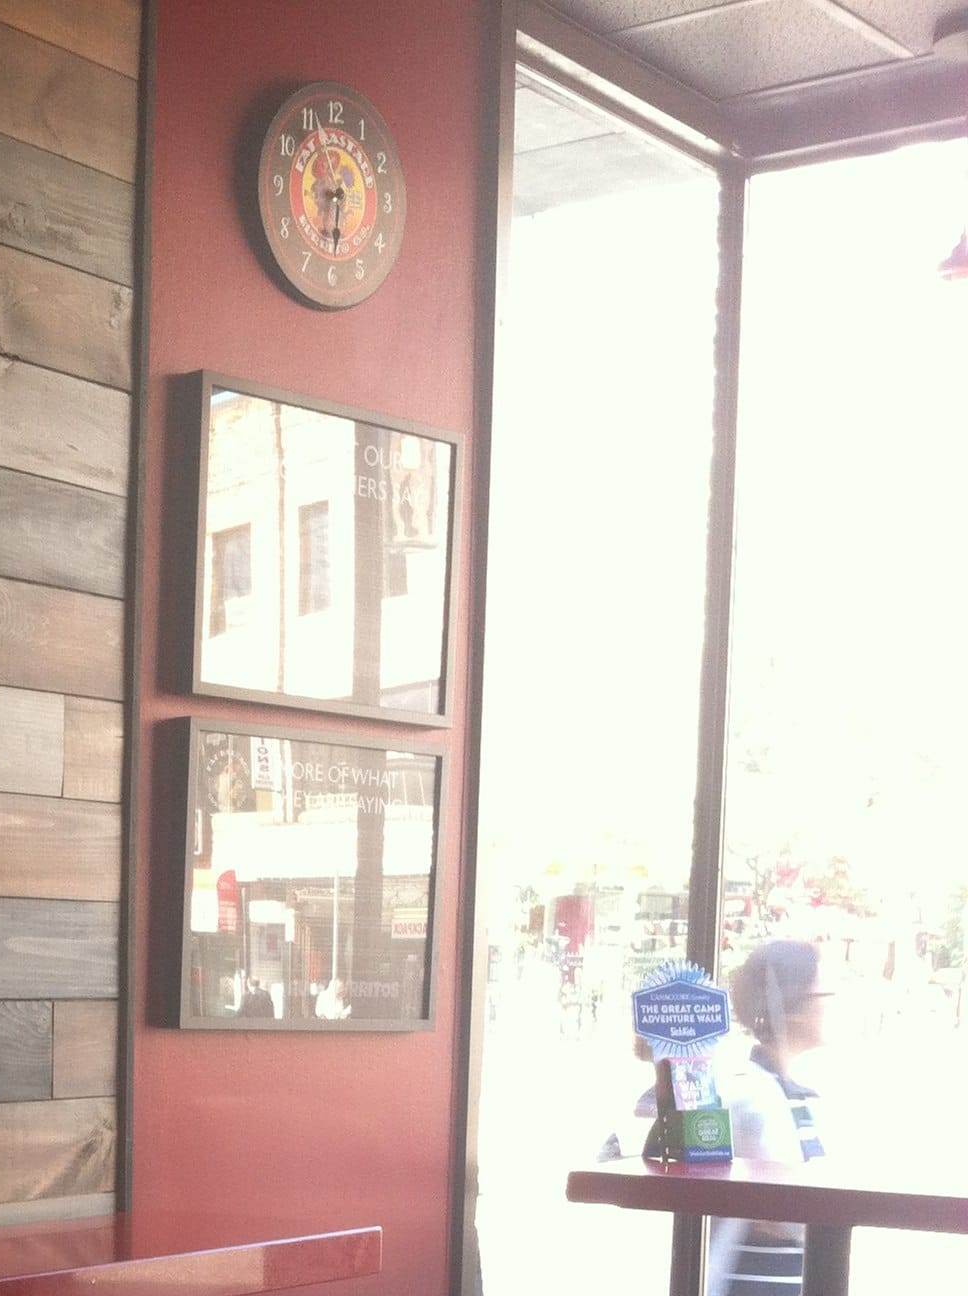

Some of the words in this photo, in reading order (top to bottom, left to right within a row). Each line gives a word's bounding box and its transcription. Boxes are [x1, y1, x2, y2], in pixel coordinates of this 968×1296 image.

[301, 108, 314, 131] 11
[328, 101, 344, 124] 12
[358, 119, 366, 141] 1
[281, 134, 295, 157] 10
[321, 132, 374, 189] ASTARD
[377, 151, 388, 174] 2
[273, 174, 284, 196] 9
[383, 192, 393, 214] 3
[280, 216, 291, 239] 8
[374, 232, 386, 254] 4
[301, 251, 312, 273] 7
[355, 259, 366, 281] 5
[327, 266, 337, 287] 6
[364, 445, 403, 473] OUR
[357, 475, 387, 502] ERS
[290, 761, 324, 782] ORE
[328, 765, 350, 783] OF
[351, 767, 399, 789] WHAT
[640, 1004, 659, 1014] THE
[661, 1004, 692, 1014] GREAT
[693, 1004, 721, 1014] CAMP
[641, 1014, 695, 1024] ADVENTURE
[696, 1014, 722, 1024] WALK
